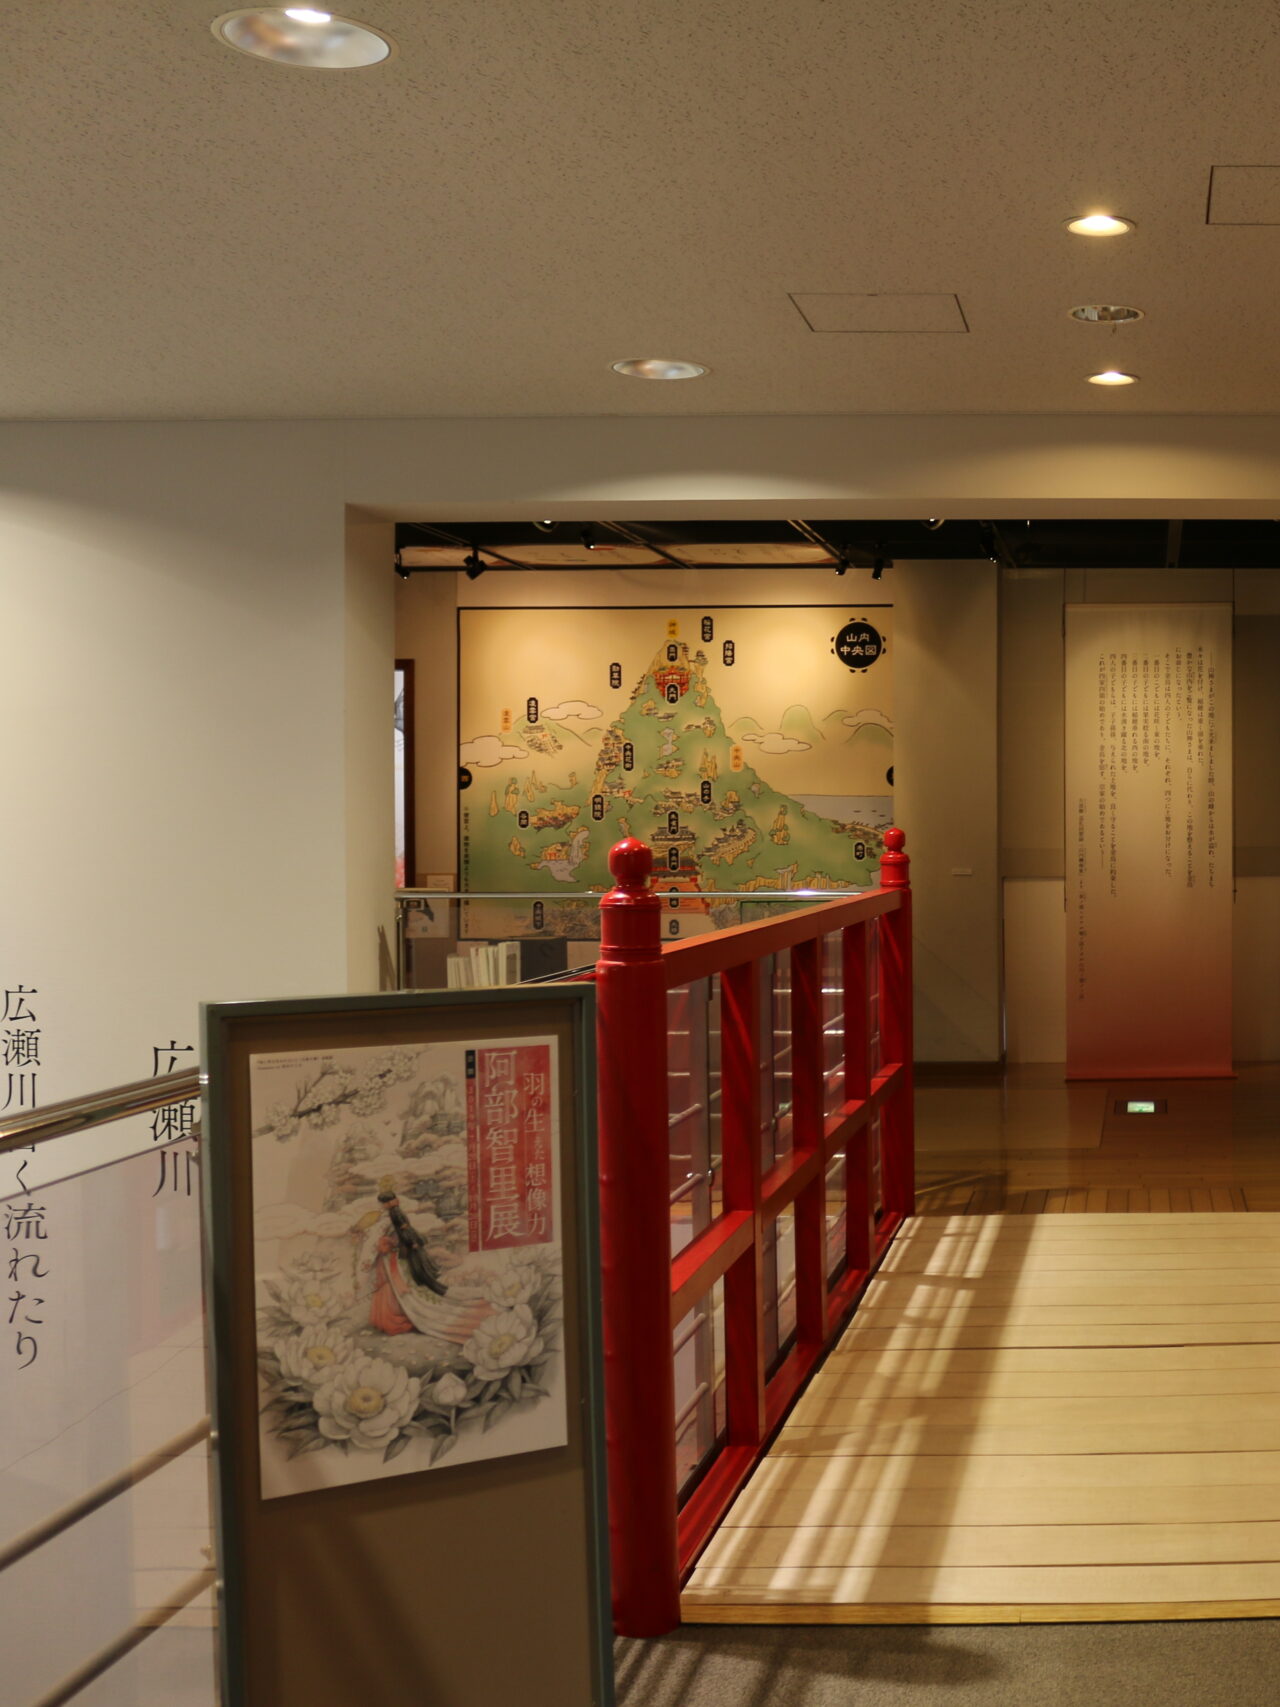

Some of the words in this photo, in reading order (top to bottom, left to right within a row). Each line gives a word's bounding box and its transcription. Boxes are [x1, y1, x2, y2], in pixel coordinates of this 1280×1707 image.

[840, 644, 877, 656] 中央図
[846, 632, 870, 643] 山内
[1, 984, 50, 1370] 広瀬川く流れたり
[484, 1050, 527, 1242] 阿部智里展
[522, 1072, 547, 1236] 羽の生えた想像力
